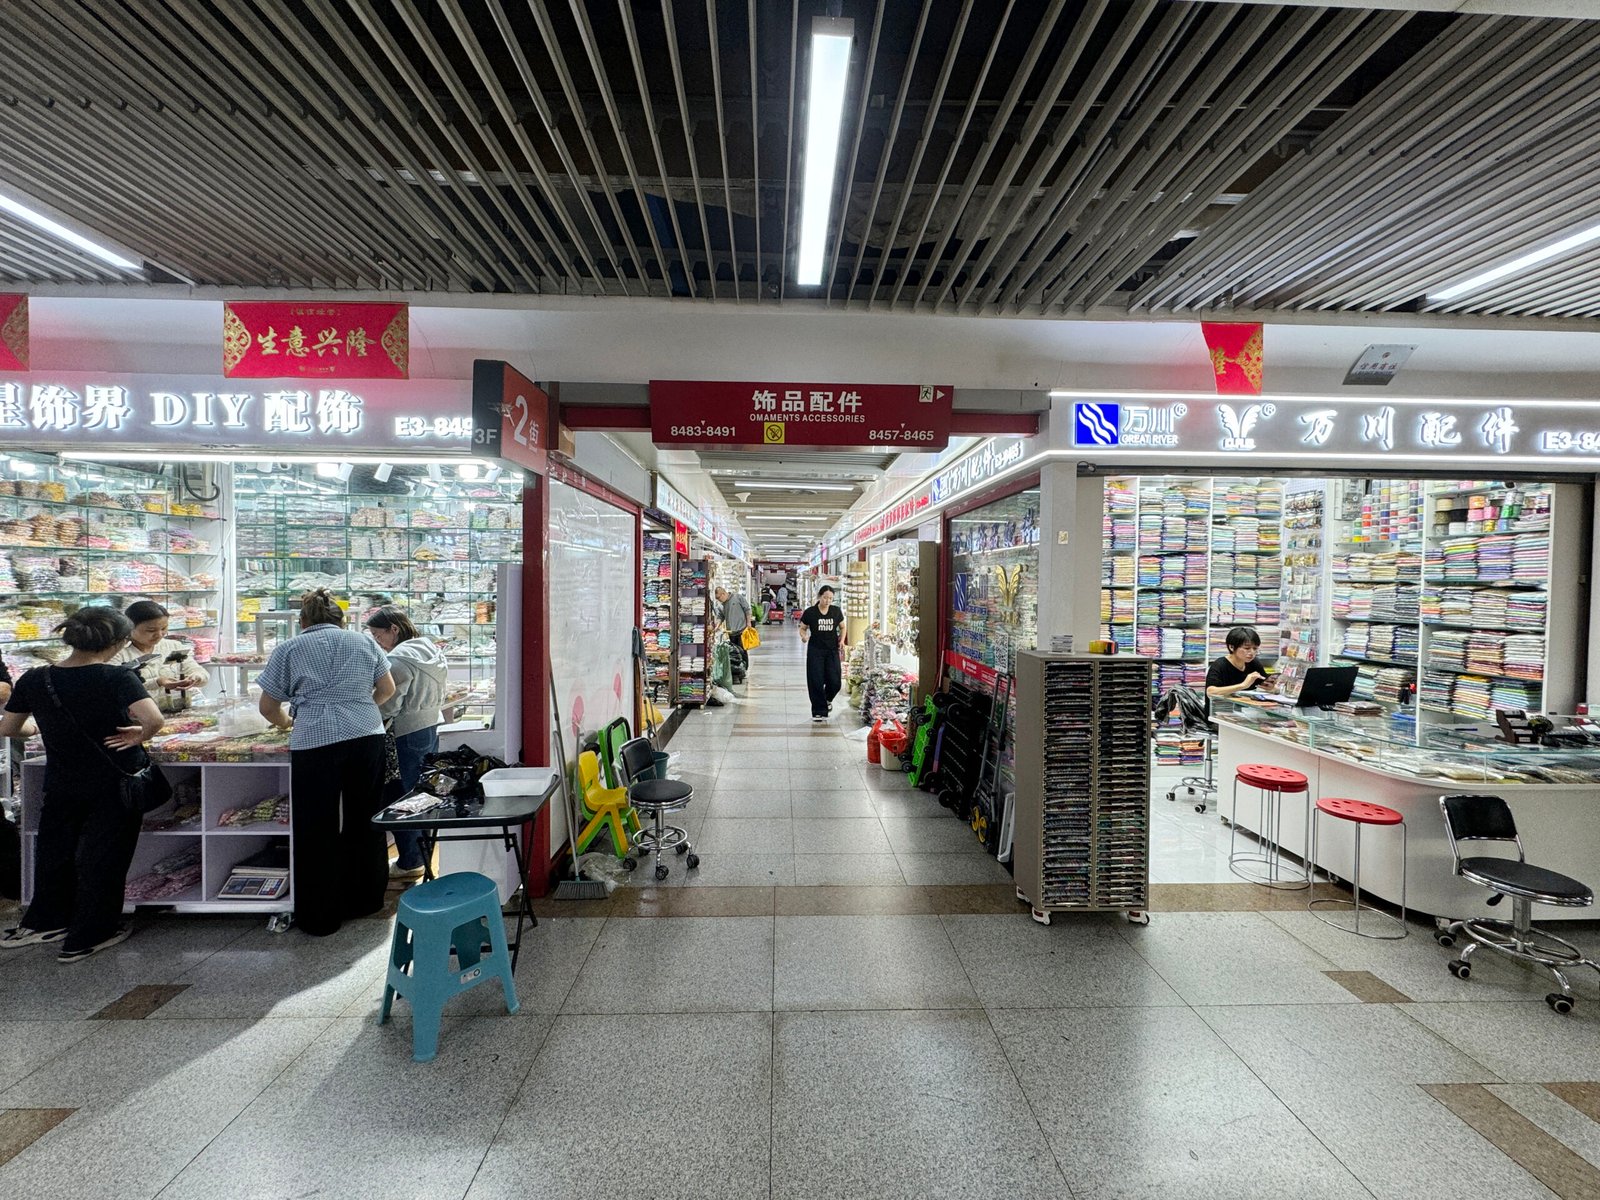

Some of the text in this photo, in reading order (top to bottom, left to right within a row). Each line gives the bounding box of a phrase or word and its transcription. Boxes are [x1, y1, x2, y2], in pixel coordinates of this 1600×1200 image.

[257, 325, 377, 358] 生意兴隆
[752, 390, 863, 413] 饰品配件
[150, 392, 250, 426] DIY
[264, 389, 361, 433] 配饰
[802, 414, 866, 423] ACCESSORIES
[474, 428, 497, 444] 3F
[670, 425, 737, 438] 8483-8491
[868, 429, 934, 442] 8457-8465
[1300, 406, 1520, 454] 万川配件
[1121, 434, 1179, 445] GREAT RIVER
